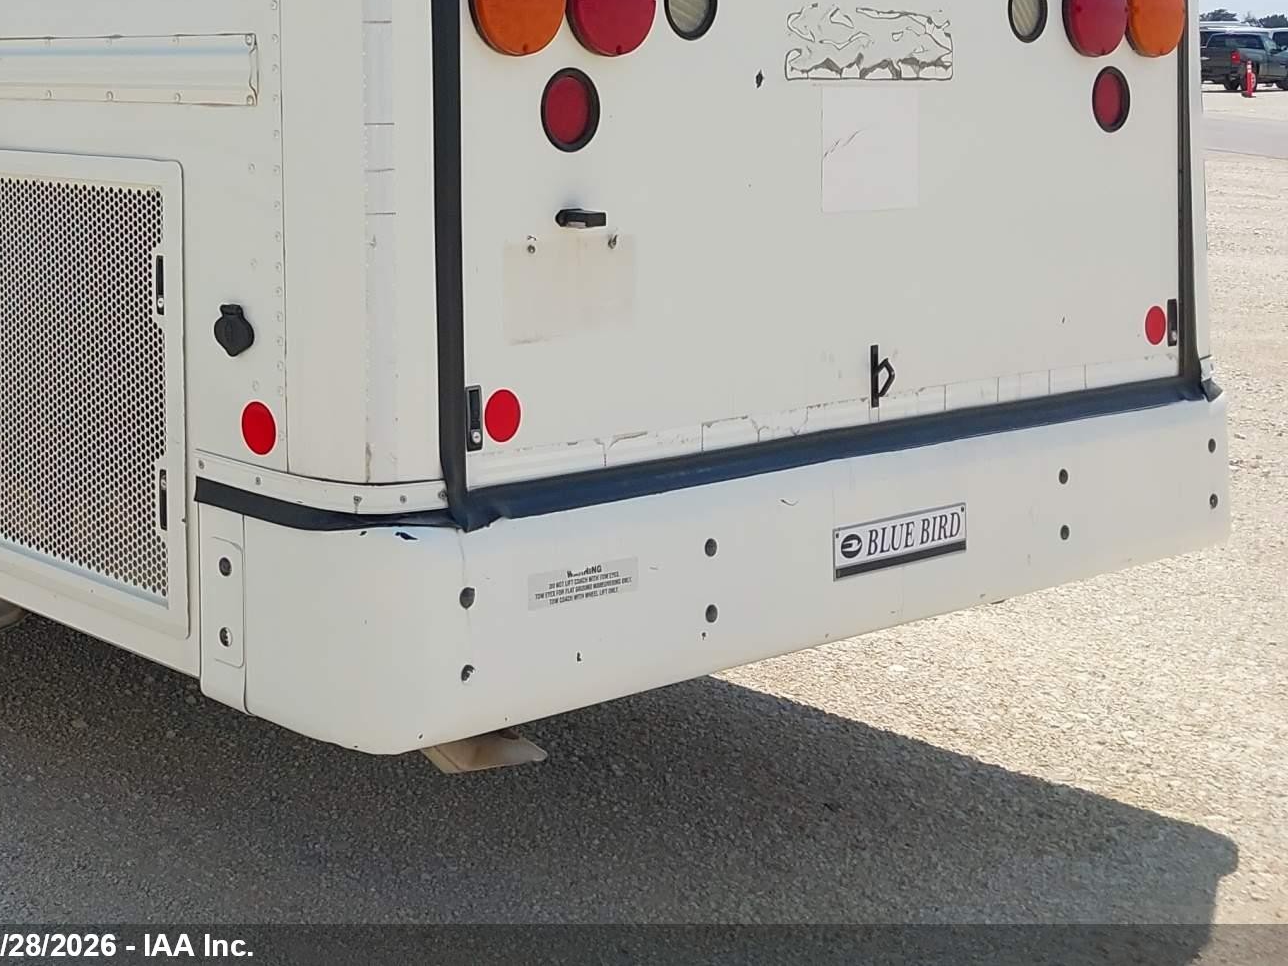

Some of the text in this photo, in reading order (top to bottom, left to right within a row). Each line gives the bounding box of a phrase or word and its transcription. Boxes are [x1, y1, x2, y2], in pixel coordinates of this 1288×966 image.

[867, 512, 961, 556] BLUE BIRD
[574, 577, 587, 585] COACH
